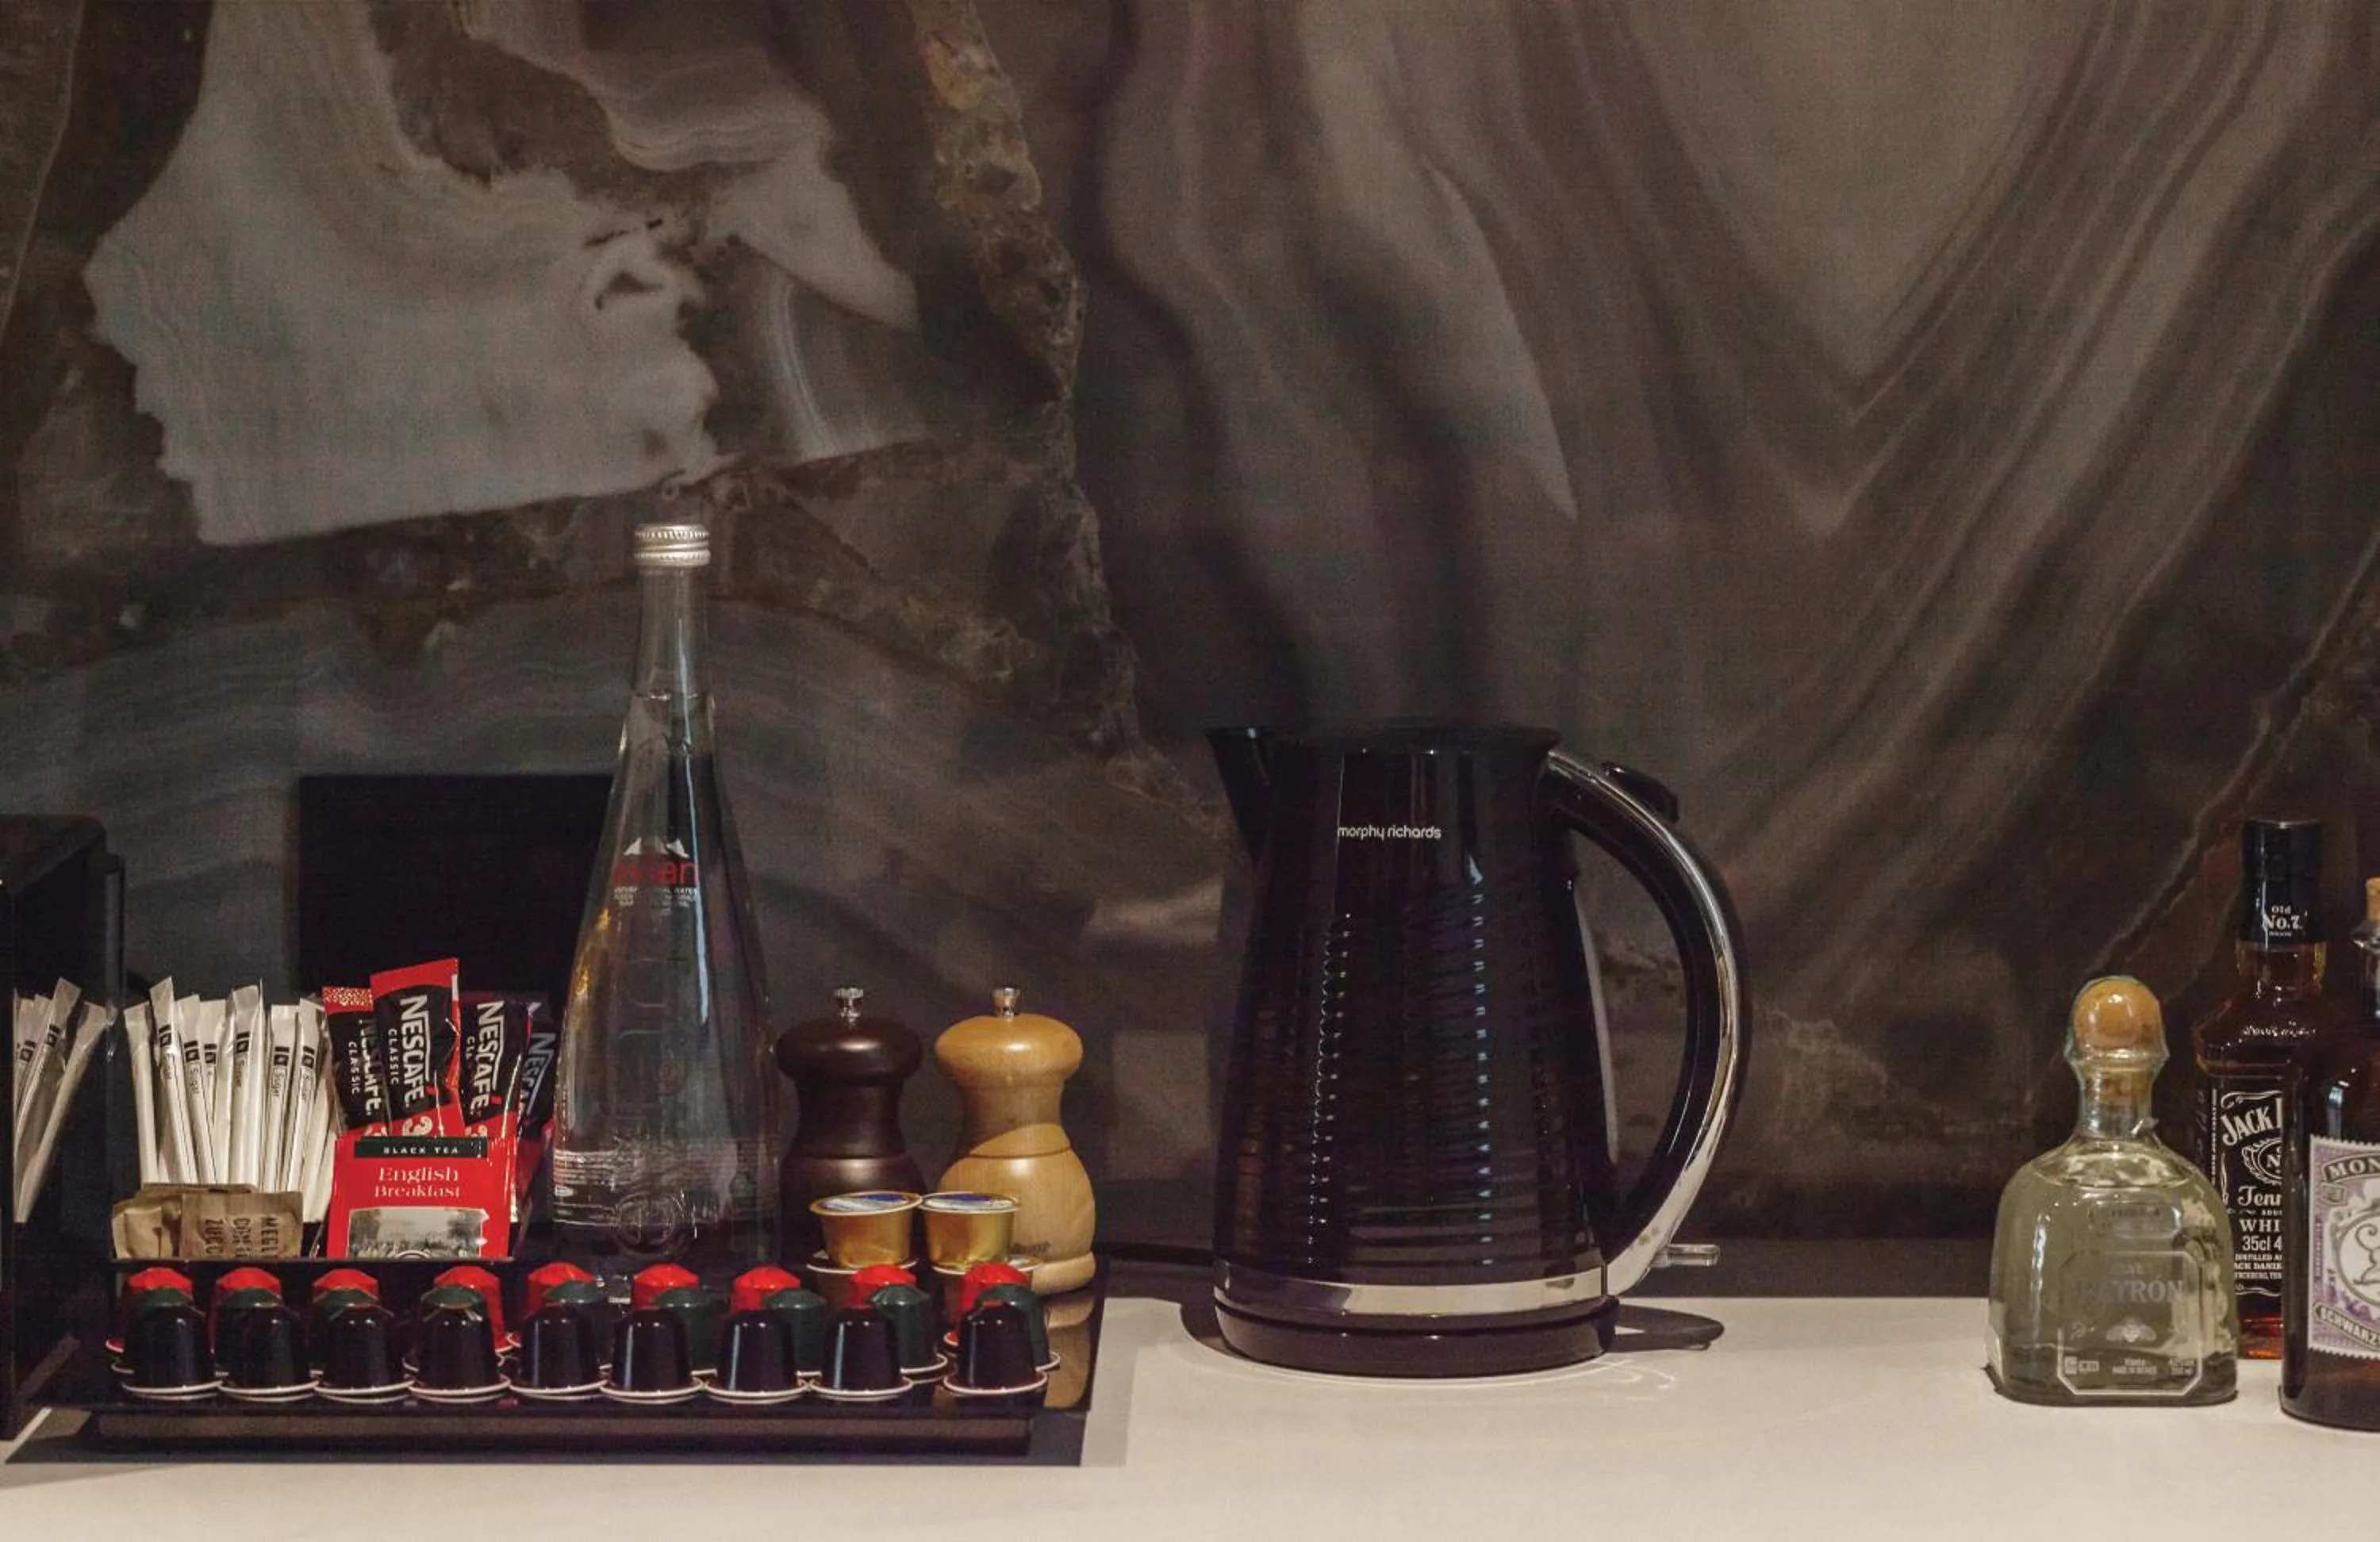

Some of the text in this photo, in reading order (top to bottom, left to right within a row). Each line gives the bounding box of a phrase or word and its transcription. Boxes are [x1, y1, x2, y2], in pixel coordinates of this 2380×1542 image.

[1338, 825, 1441, 842] morphy richards
[388, 1028, 399, 1085] CLASSIC
[347, 1041, 360, 1095] CLASSIC
[2221, 1106, 2274, 1146] JACK
[384, 1146, 426, 1155] BLACK
[378, 1167, 459, 1184] English
[2328, 1157, 2380, 1180] MON
[374, 1184, 460, 1199] Breakfast
[2239, 1218, 2281, 1233] WHI
[2242, 1235, 2283, 1252] 35cl 4
[2320, 1307, 2380, 1346] SCHWARZ
